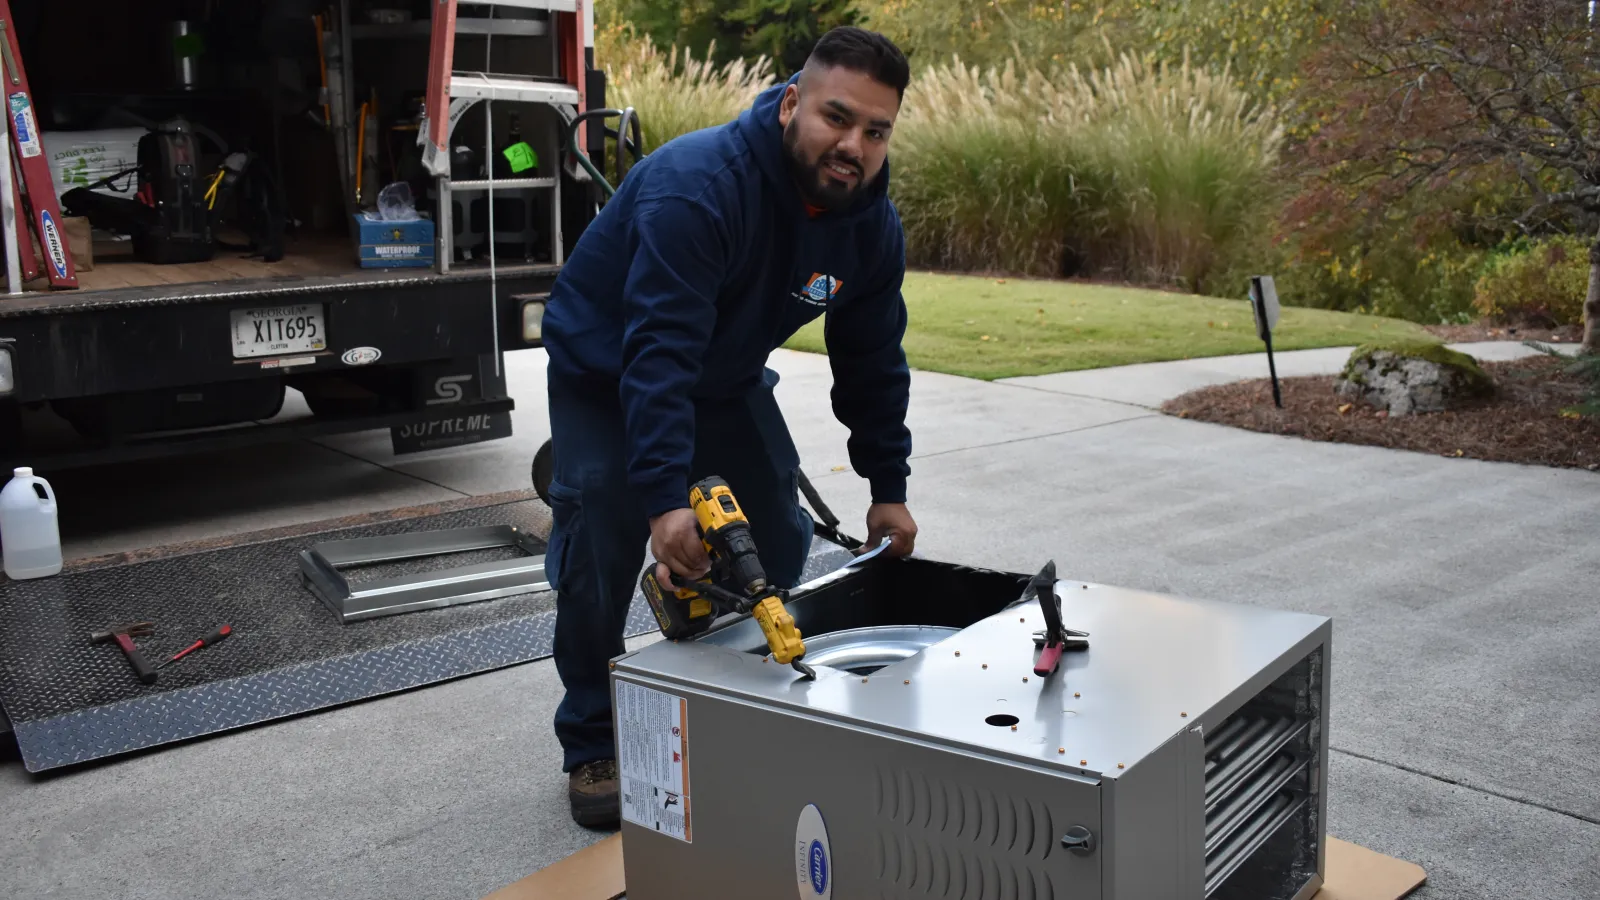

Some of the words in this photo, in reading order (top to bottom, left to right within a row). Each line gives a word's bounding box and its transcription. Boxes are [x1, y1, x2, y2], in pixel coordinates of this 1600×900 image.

[54, 149, 80, 160] DUCT
[46, 223, 63, 266] WERNER
[375, 245, 420, 255] WATERPROOF
[252, 306, 303, 319] GEORGIA
[253, 315, 317, 343] XIT695
[400, 414, 491, 439] SUPREME
[799, 840, 807, 884] INFINITY
[814, 847, 823, 888] Carrier
